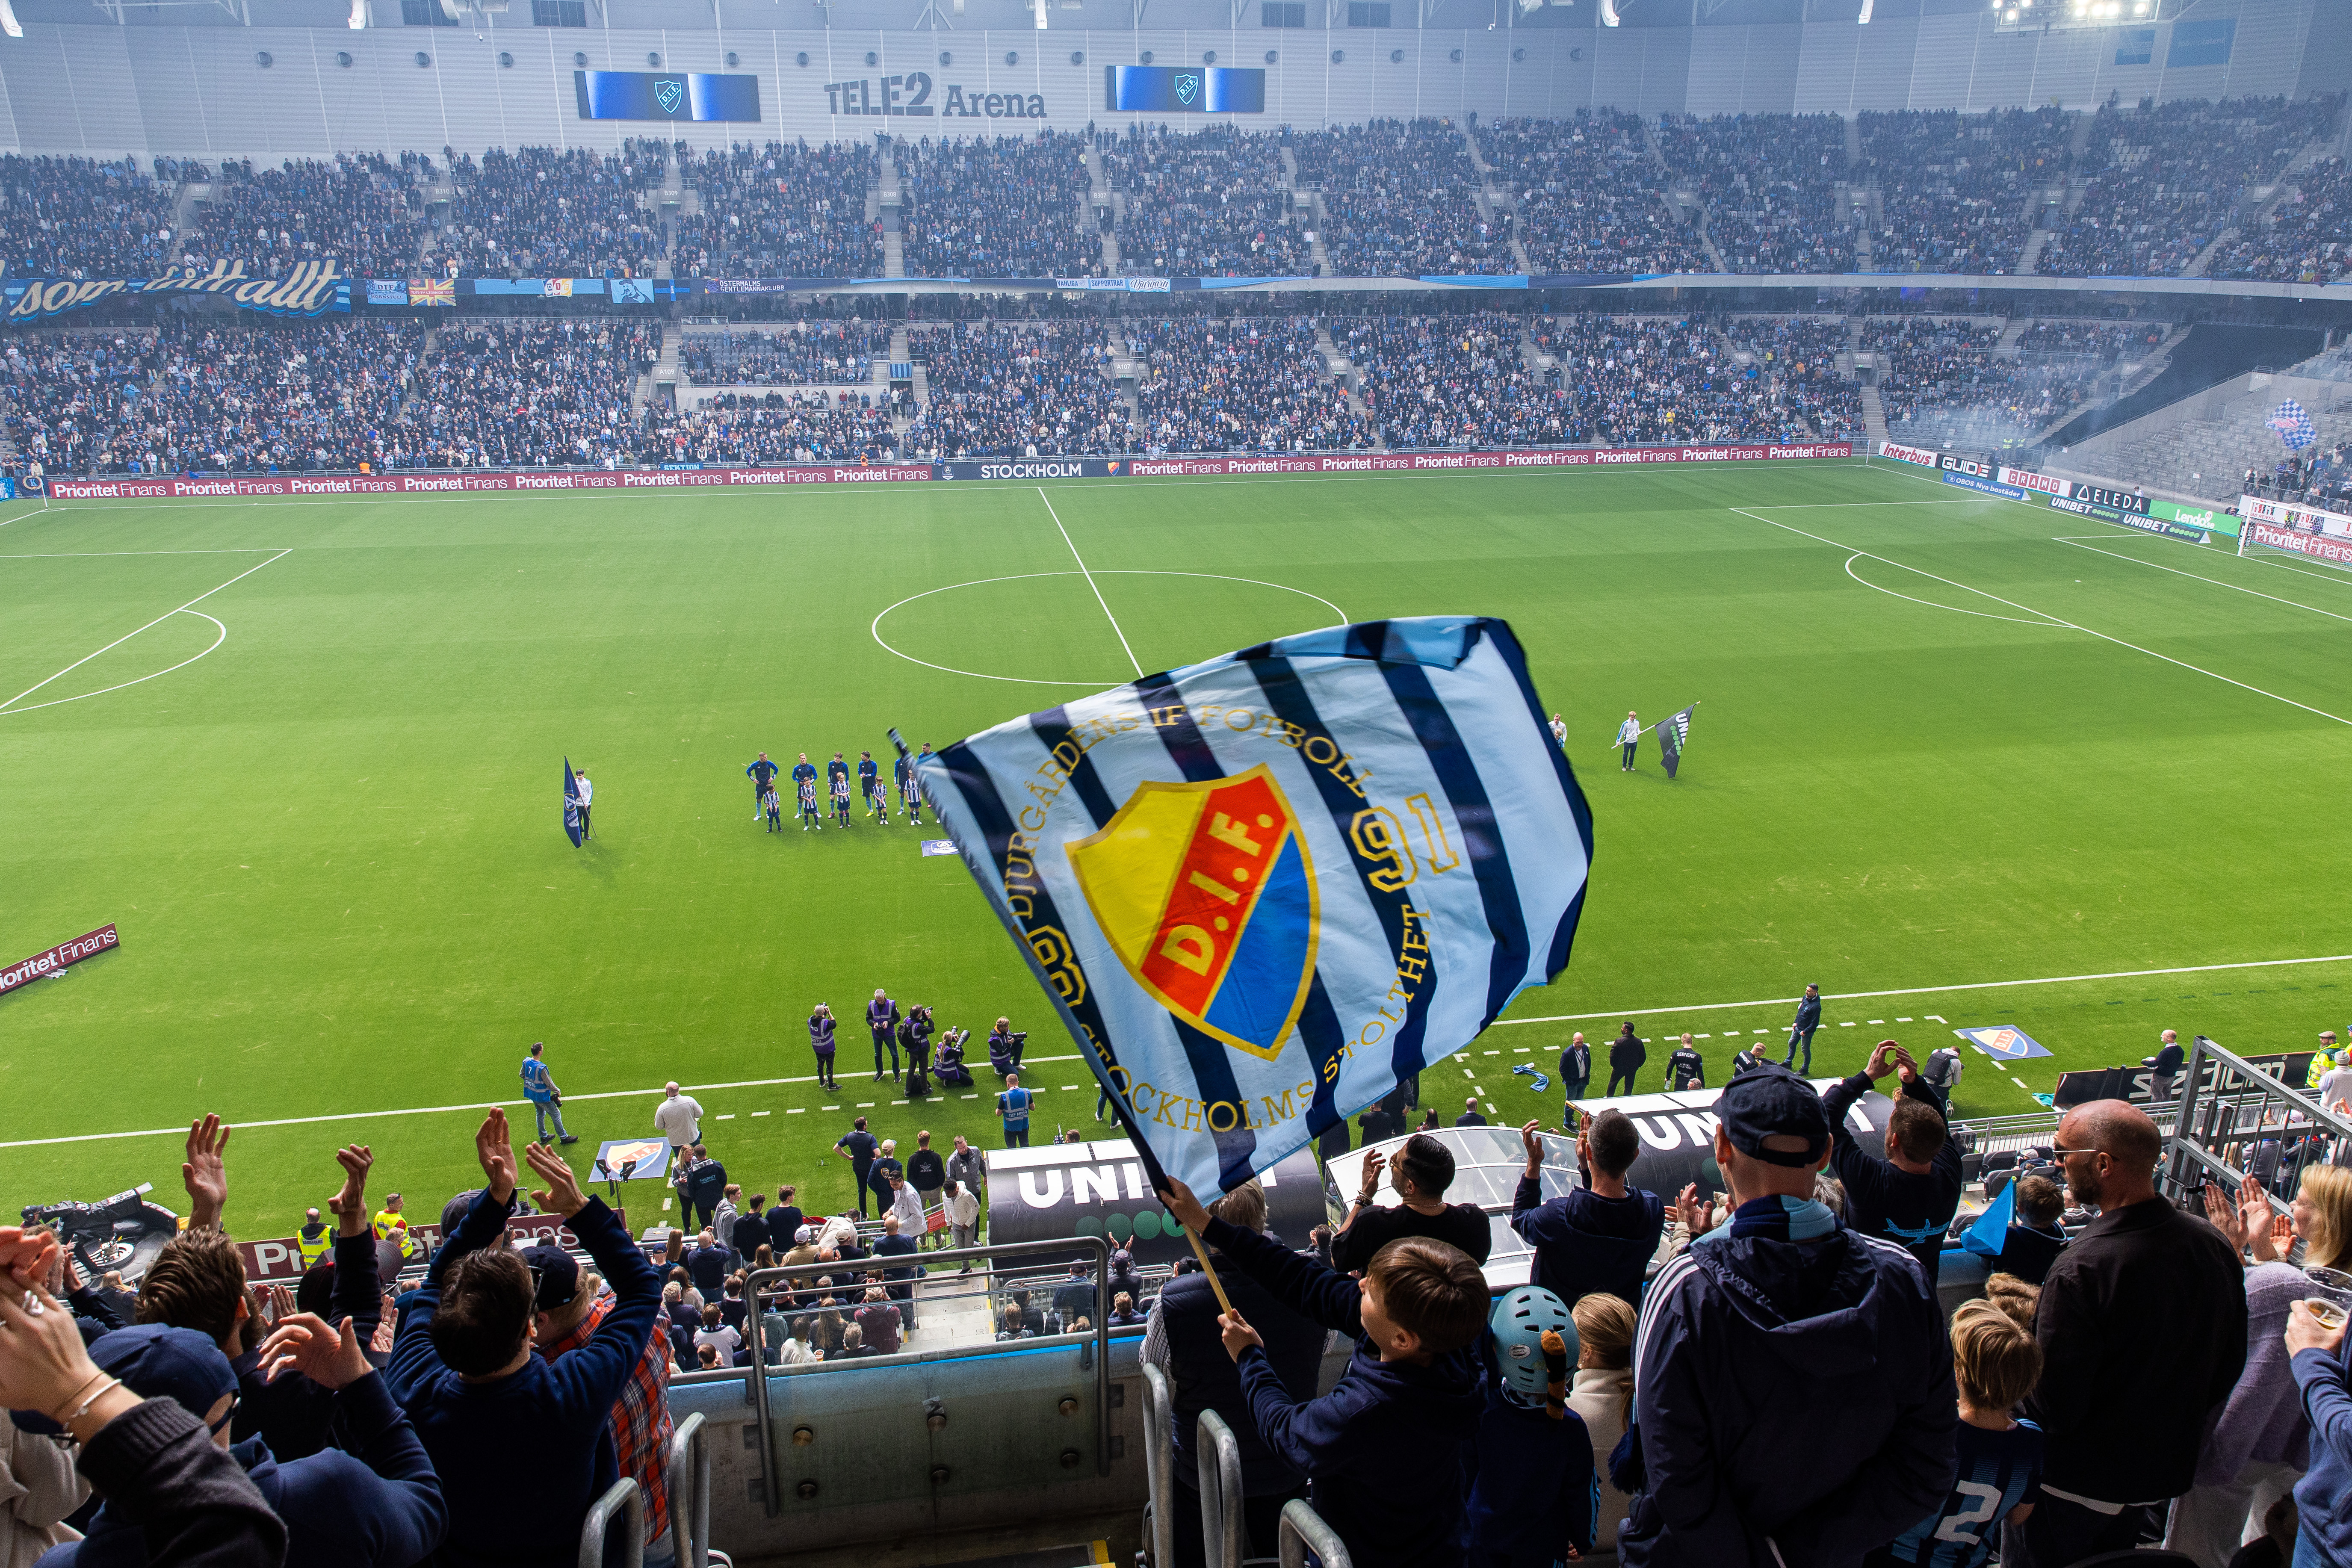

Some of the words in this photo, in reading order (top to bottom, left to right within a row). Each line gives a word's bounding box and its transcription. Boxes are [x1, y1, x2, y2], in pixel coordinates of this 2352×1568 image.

[662, 86, 679, 102] D.I.F.
[1180, 79, 1196, 94] D.I.F.
[824, 72, 934, 116] TELE2
[943, 85, 1047, 118] Arena
[9, 280, 127, 316] som
[235, 260, 342, 310] allt
[1130, 278, 1168, 291] Djurgårn
[1506, 453, 1553, 466] Prioritet
[1554, 453, 1588, 464] Finans
[1596, 451, 1641, 464] Prioritet
[1643, 451, 1676, 462] Finans
[1683, 449, 1728, 461] Prioritet
[1730, 449, 1763, 460] Finans
[1770, 447, 1814, 459] Prioritet
[1816, 446, 1847, 458] Finans
[1883, 443, 1931, 466] Interbus
[1133, 462, 1183, 475] Prioritet
[1185, 462, 1221, 473] Finans
[1229, 460, 1278, 472] Prioritet
[1280, 460, 1315, 471] Finans
[1323, 458, 1371, 470] Prioritet
[1373, 458, 1408, 469] Finans
[1415, 455, 1463, 468] Prioritet
[1464, 455, 1499, 467] Finans
[1942, 457, 1989, 478] GUIDE
[731, 471, 785, 484] Prioritet
[787, 471, 826, 482] Finans
[834, 469, 887, 482] Prioritet
[889, 469, 928, 481] Finans
[981, 463, 1081, 479] STOCKHOLM
[291, 480, 351, 493] Prioritet
[353, 480, 396, 492] Finans
[405, 478, 462, 490] Prioritet
[465, 477, 508, 489] Finans
[516, 475, 573, 488] Prioritet
[575, 475, 616, 487] Finans
[625, 472, 680, 486] Prioritet
[682, 472, 722, 484] Finans
[2010, 473, 2059, 492] CRAMO
[55, 482, 118, 497] Prioritet
[121, 482, 166, 496] Finans
[175, 482, 236, 495] Prioritet
[238, 482, 282, 495] Finans
[1955, 477, 1974, 487] OBOS
[1976, 481, 1989, 492] Nya
[1990, 485, 2020, 498] bostäder
[2051, 496, 2093, 514] UNIBET
[2094, 489, 2142, 512] ELEDA
[2123, 514, 2170, 532] UNIBET
[2254, 526, 2308, 551] Prioritet
[2309, 537, 2352, 561] Finans
[1005, 712, 1141, 919] DJURGÅRDENS
[1149, 705, 1187, 727] IF
[1198, 706, 1374, 798] FOTBOLL
[1350, 792, 1460, 892] 91
[1160, 811, 1274, 977] D.I.F.
[59, 930, 117, 962] Finans
[1080, 1023, 1314, 1133] STOCKHOLMS
[1324, 904, 1430, 1083] STOLTHET
[1995, 1032, 2014, 1048] D.I.F.
[525, 1079, 536, 1088] PHOTO
[1934, 1479, 2003, 1545] 2
